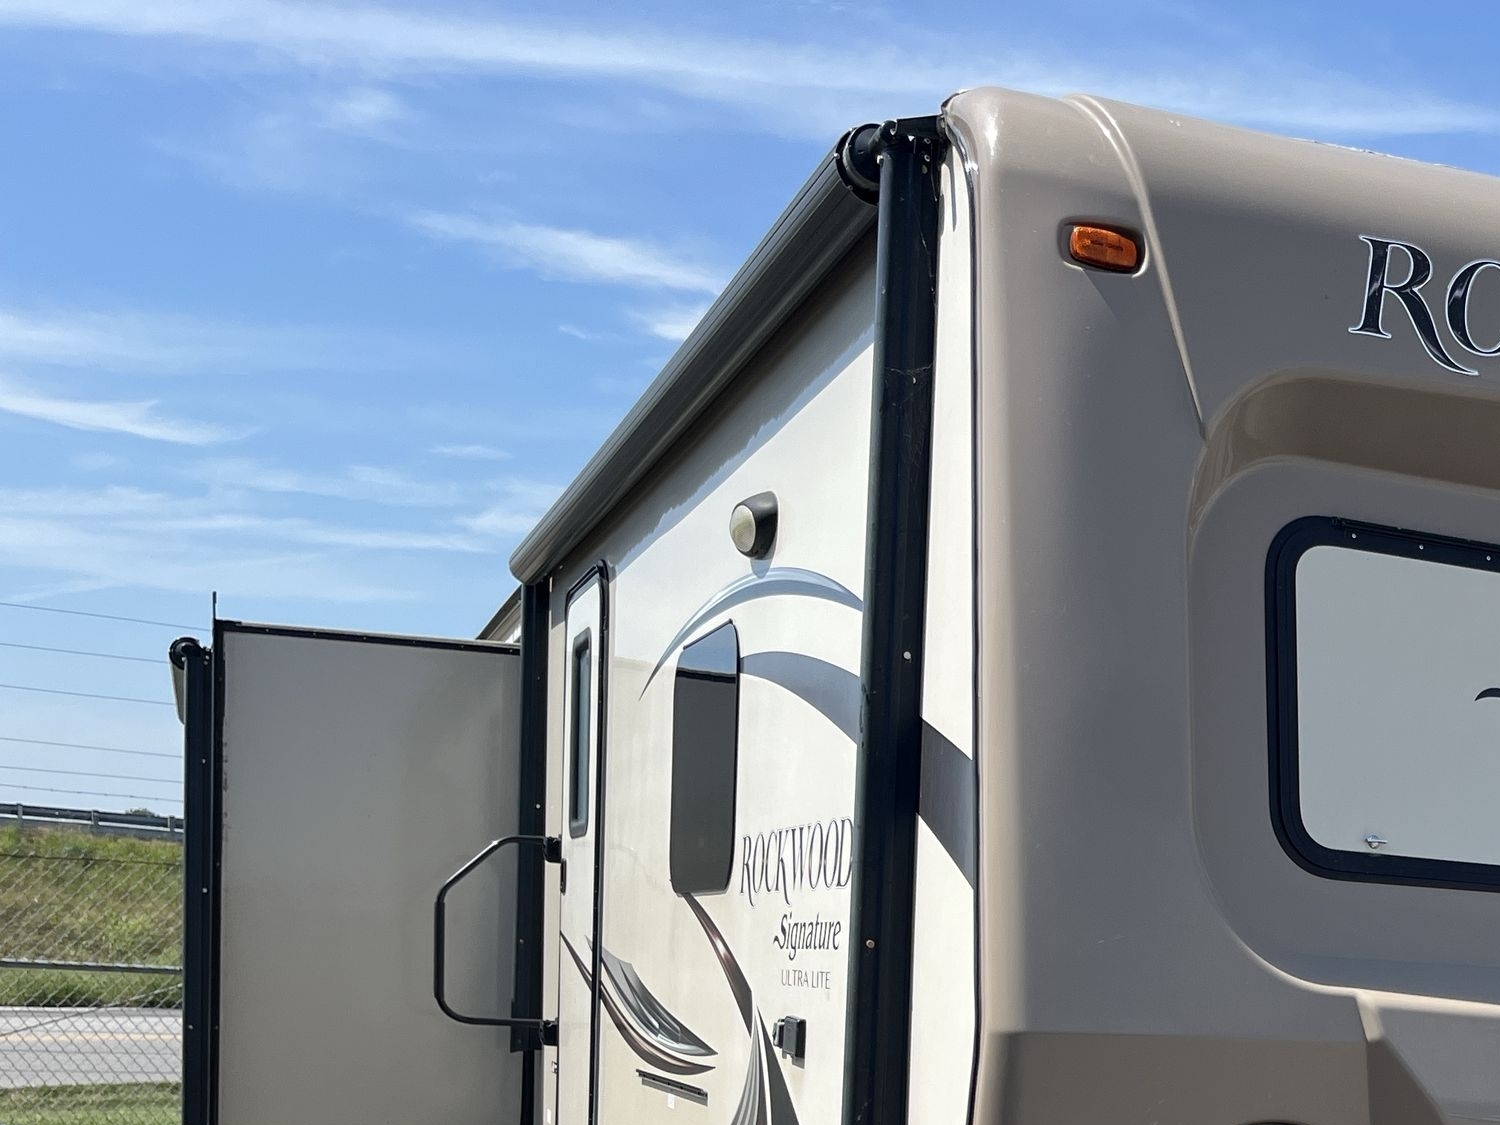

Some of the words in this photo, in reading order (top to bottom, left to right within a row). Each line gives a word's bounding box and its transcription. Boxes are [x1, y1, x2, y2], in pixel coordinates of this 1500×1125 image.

[740, 817, 854, 907] ROCKWOOD
[773, 911, 841, 961] Signature
[781, 969, 809, 988] ULTRA
[811, 971, 831, 990] LITE
